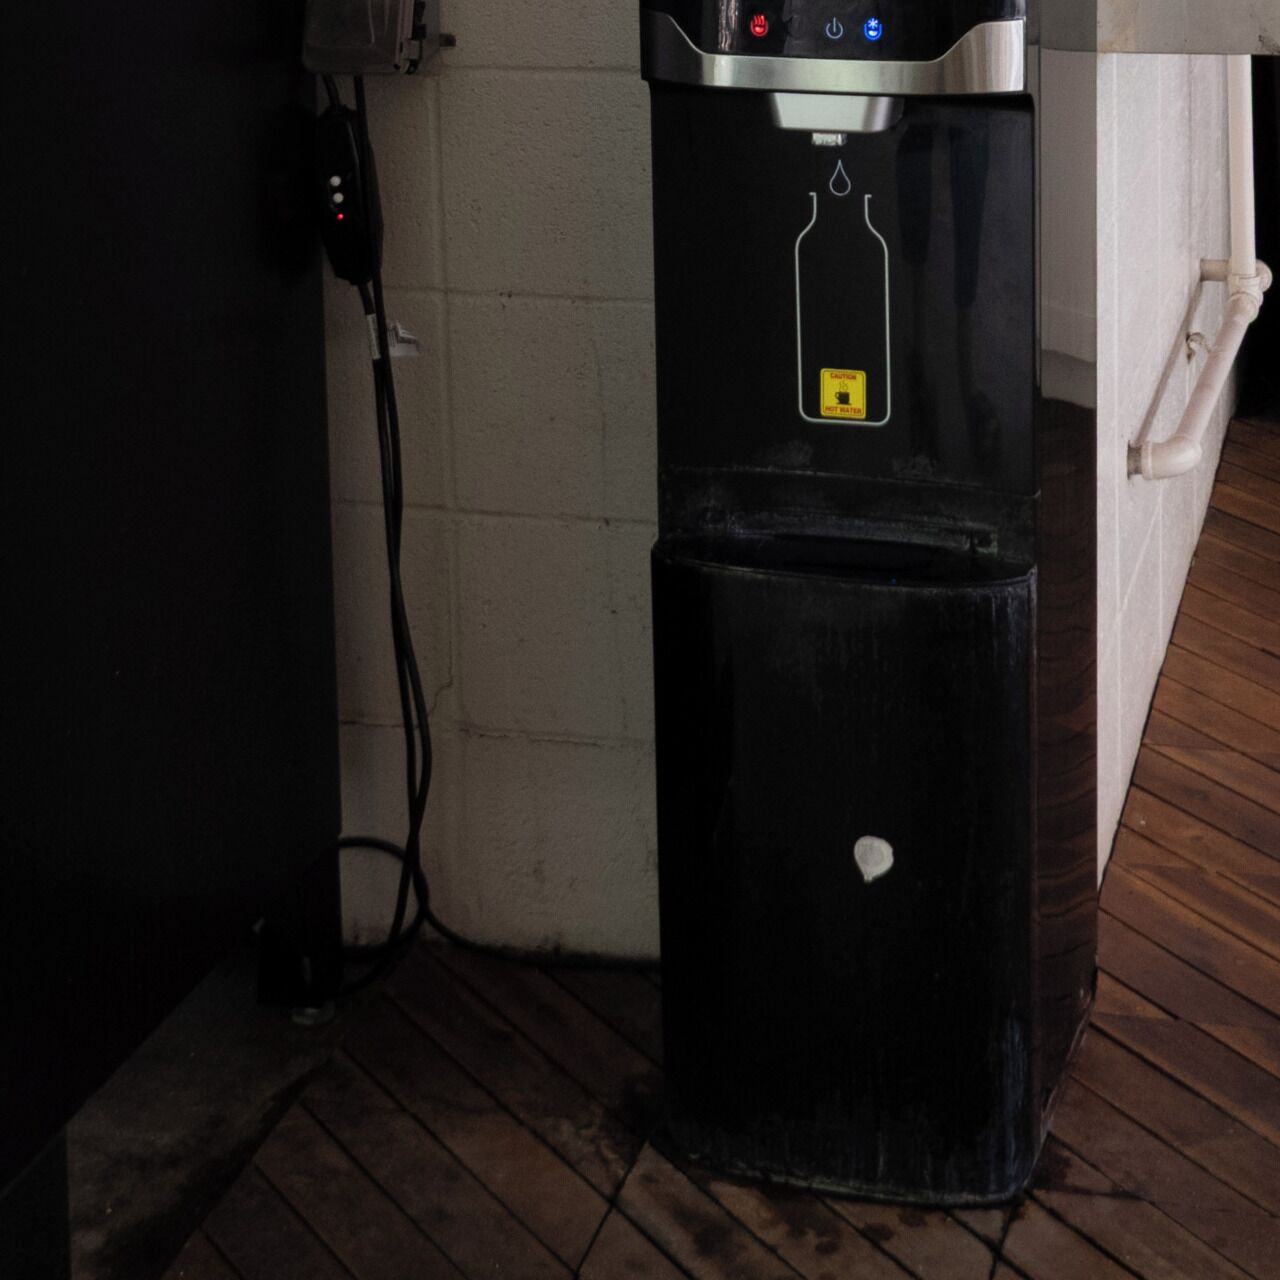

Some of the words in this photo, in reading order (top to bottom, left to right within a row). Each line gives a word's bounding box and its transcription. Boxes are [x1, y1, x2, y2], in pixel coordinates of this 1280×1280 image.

[830, 372, 857, 381] CAUTION
[825, 405, 838, 414] HOT
[839, 406, 863, 415] WATER
